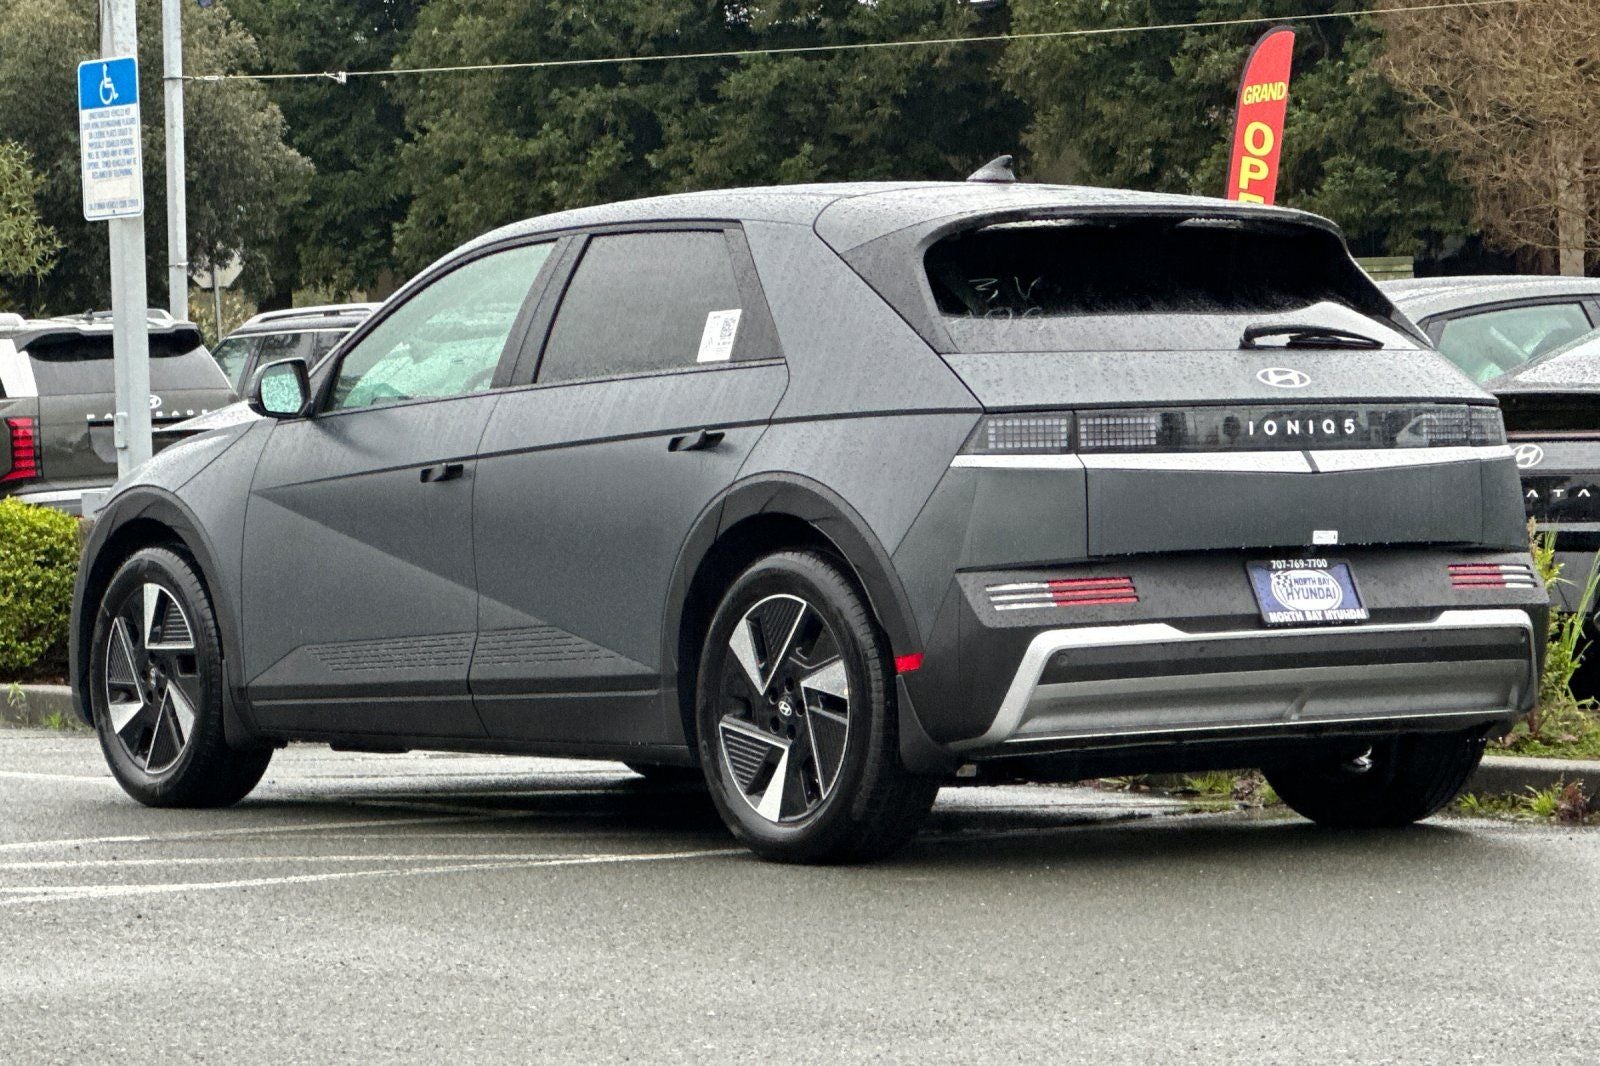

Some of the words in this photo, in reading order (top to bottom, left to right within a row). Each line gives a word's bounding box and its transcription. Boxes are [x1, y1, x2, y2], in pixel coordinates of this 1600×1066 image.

[1243, 81, 1287, 105] GRAND
[1526, 489, 1591, 498] ATA
[1270, 558, 1328, 569] 707-769-7700
[1294, 577, 1317, 587] NORTH
[1318, 576, 1331, 586] BAY
[1286, 585, 1337, 601] HYUNDAI
[1268, 610, 1304, 623] NORTH
[1305, 610, 1323, 621] BAY
[1324, 608, 1367, 620] HYUNDAI
